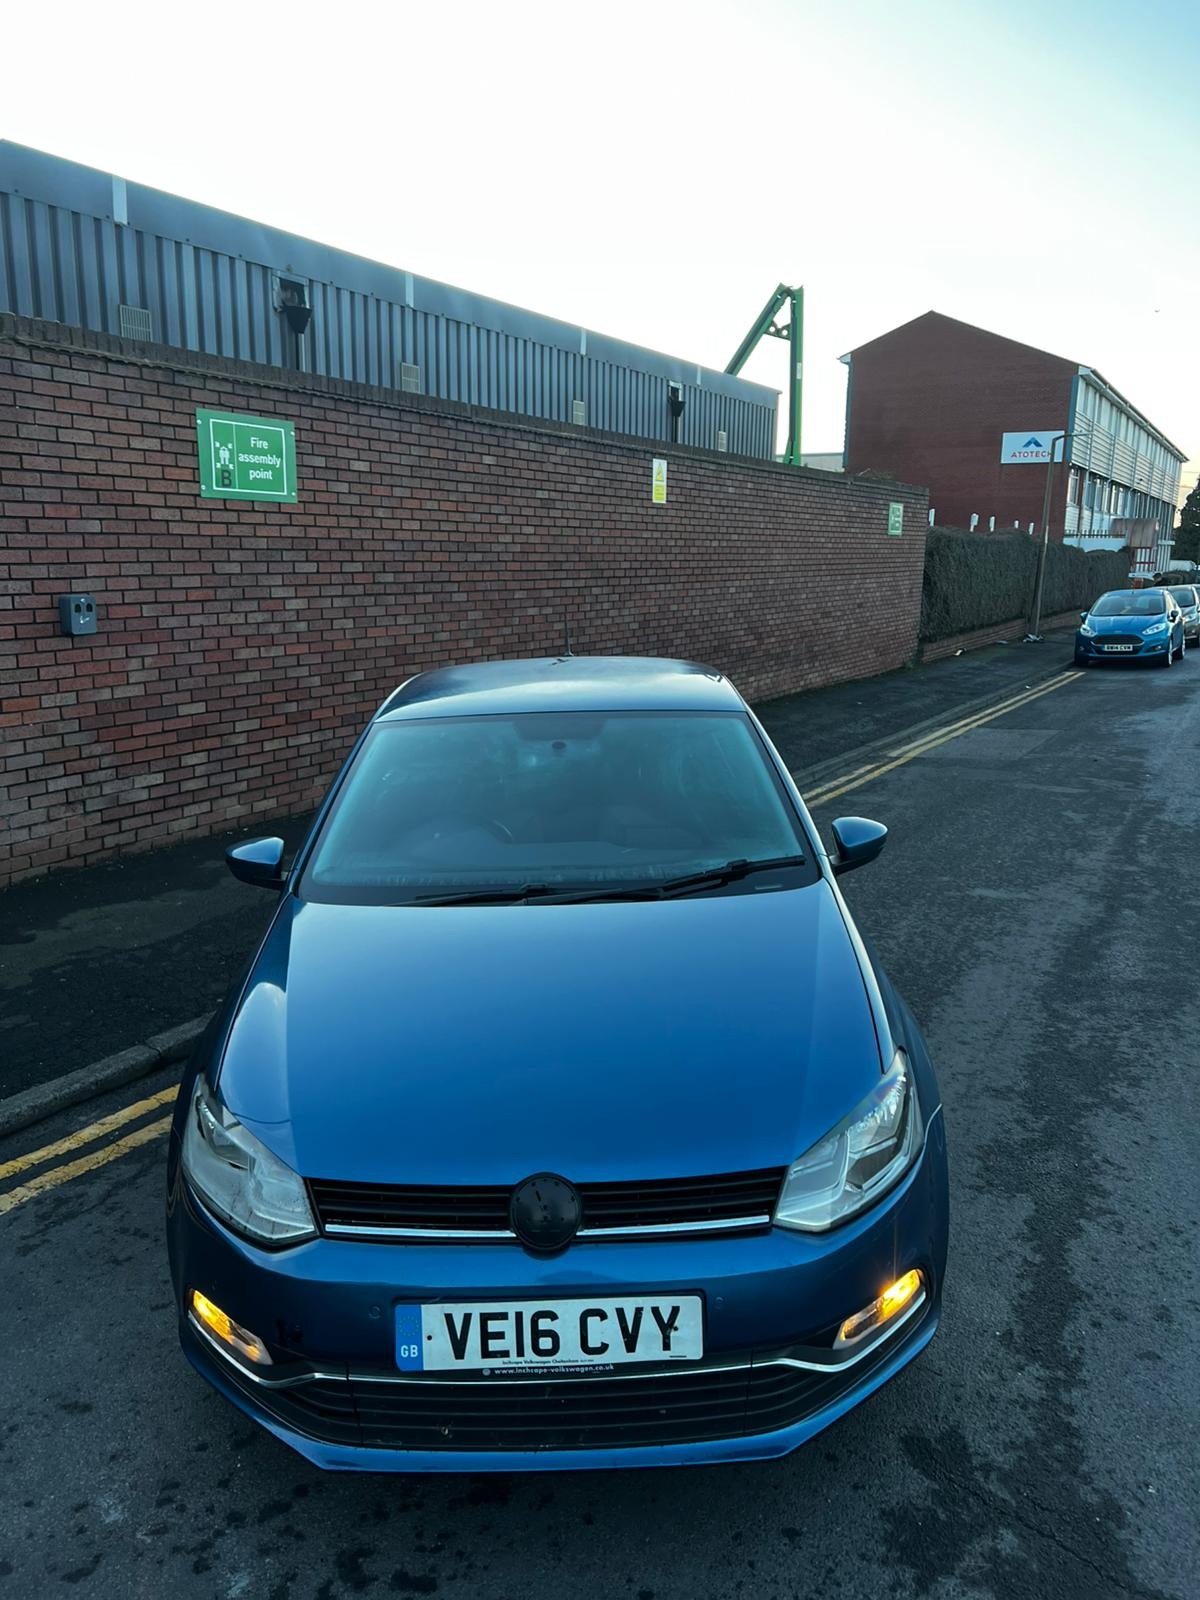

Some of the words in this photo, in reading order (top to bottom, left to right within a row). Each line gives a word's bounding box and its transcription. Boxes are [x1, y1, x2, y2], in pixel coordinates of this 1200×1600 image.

[250, 437, 269, 449] Fire
[238, 453, 281, 468] assembly
[221, 469, 232, 487] B
[249, 468, 273, 480] point
[444, 1310, 560, 1359] VE16
[579, 1305, 681, 1355] CVY
[400, 1344, 418, 1358] GB
